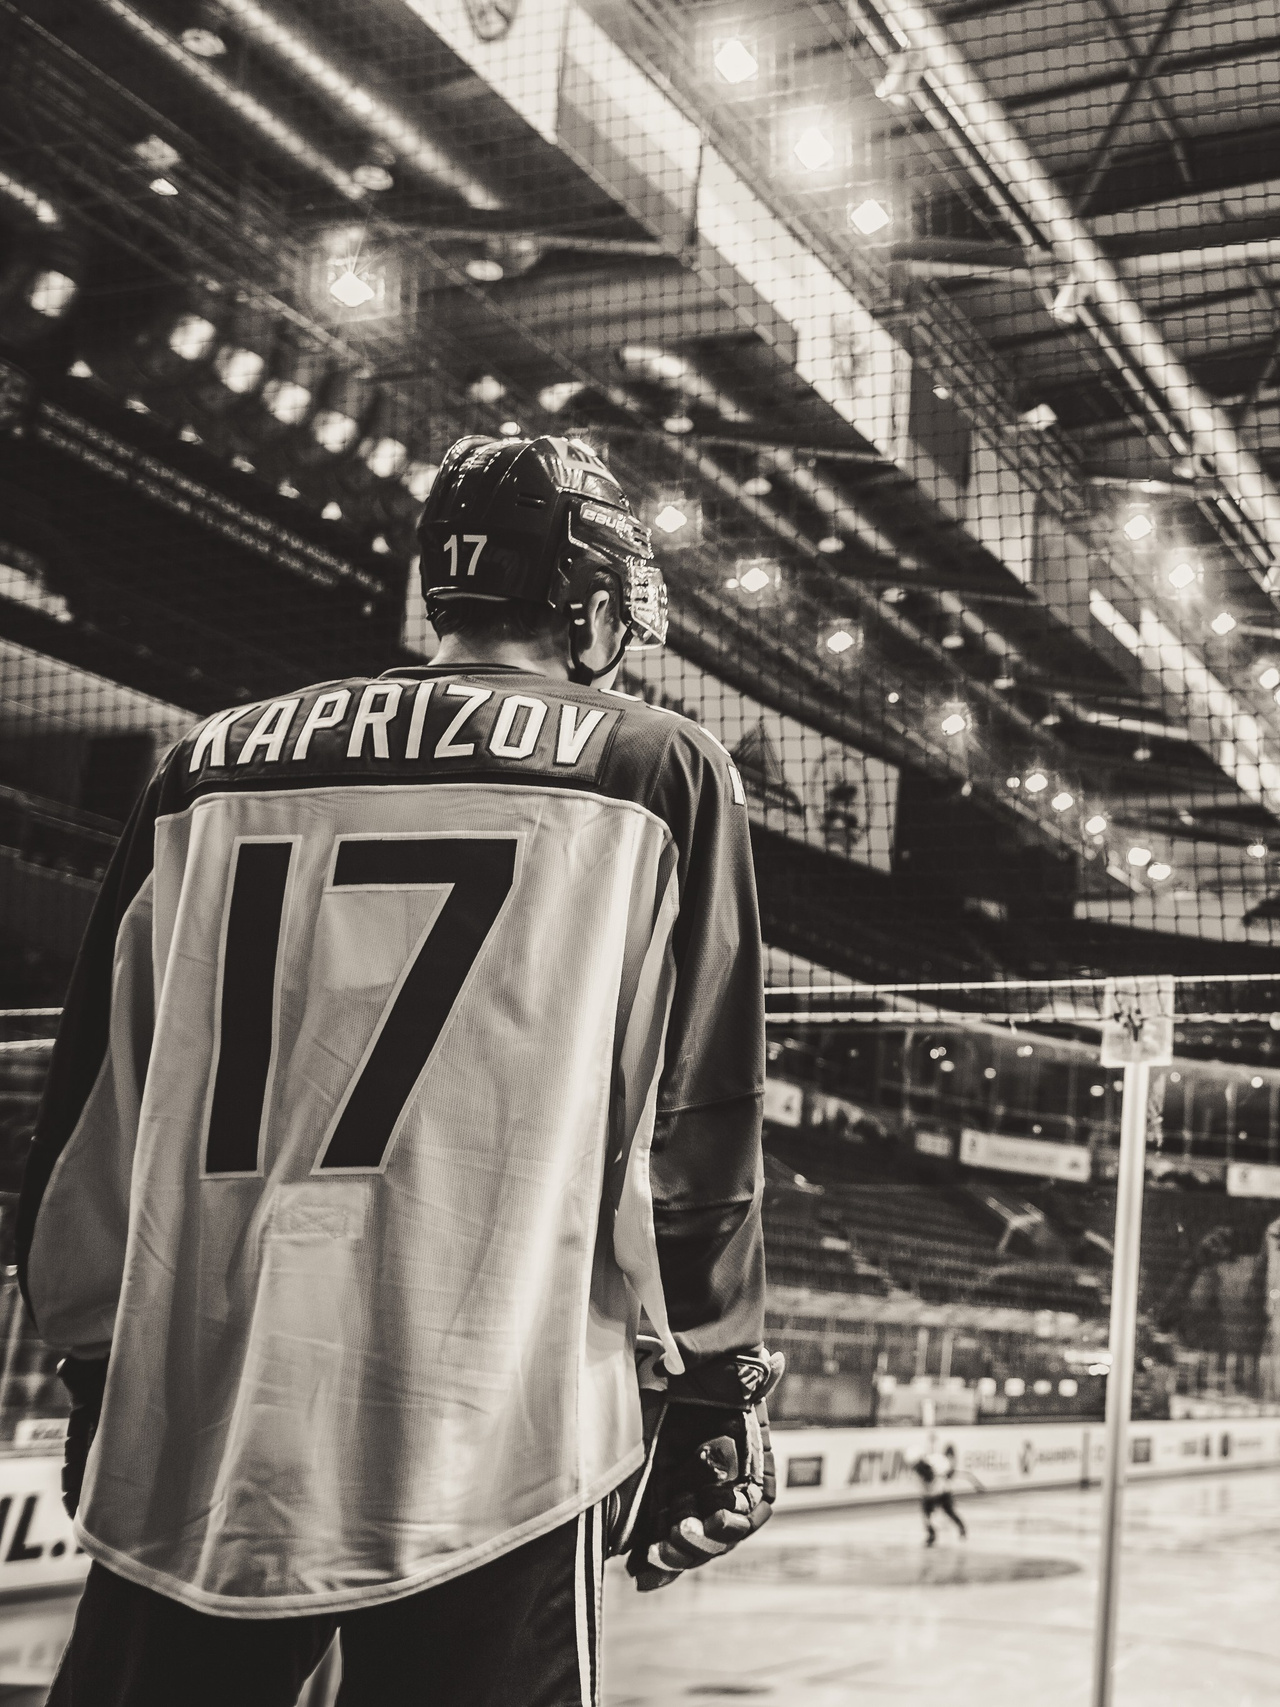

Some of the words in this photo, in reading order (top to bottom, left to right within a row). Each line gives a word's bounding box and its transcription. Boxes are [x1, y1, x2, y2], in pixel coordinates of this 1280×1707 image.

[443, 534, 488, 576] 17
[189, 682, 606, 773] KAPRIZOV
[199, 830, 527, 1180] 17
